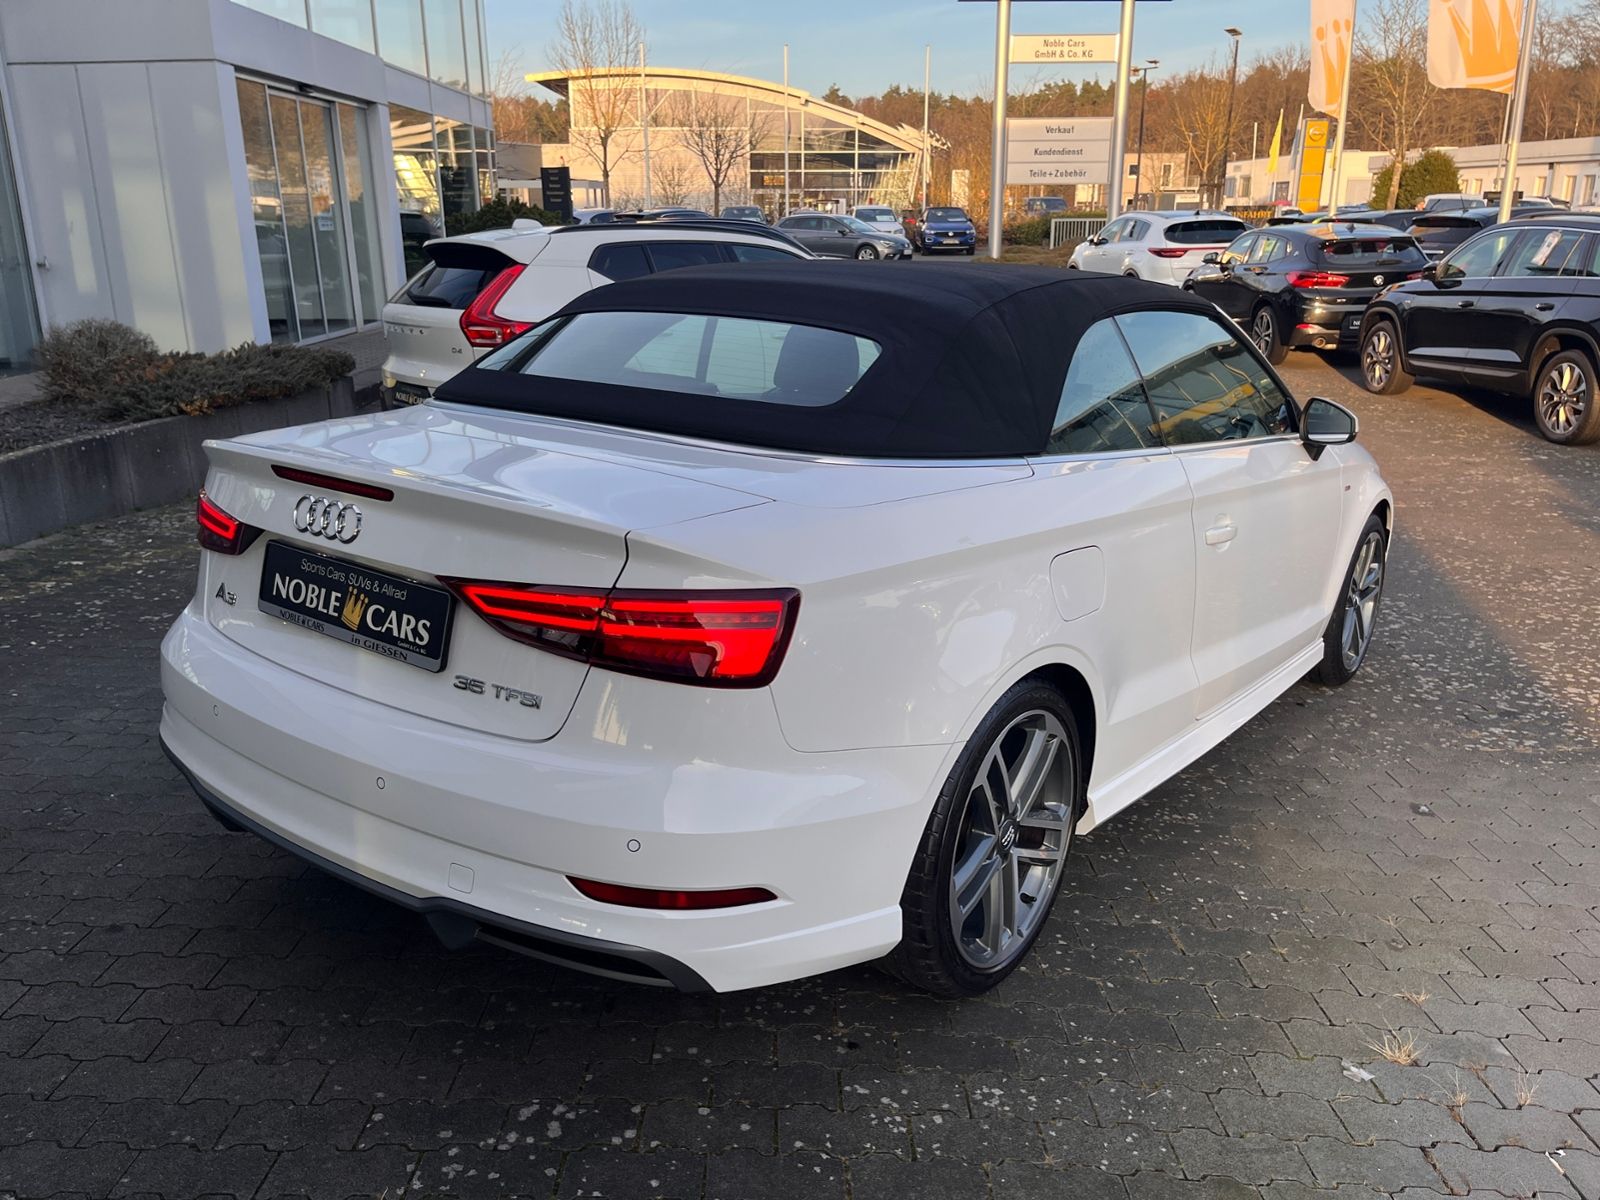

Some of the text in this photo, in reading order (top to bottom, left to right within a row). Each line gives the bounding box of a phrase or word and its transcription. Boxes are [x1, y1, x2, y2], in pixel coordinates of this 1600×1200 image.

[1034, 50, 1093, 58] GmbH & Co. KG
[1043, 39, 1085, 47] Noble Cars
[1045, 125, 1075, 134] Verkauf
[1034, 147, 1083, 156] Kundendienst
[1029, 169, 1087, 178] Teile+Zubehör
[301, 558, 408, 601] Sports Cars, SUVs & Allrad
[215, 582, 237, 606] A3
[272, 573, 431, 646] NOBLE CARS
[280, 609, 325, 632] NOBLE CARS
[351, 634, 408, 661] in GIESSEN
[453, 674, 543, 709] 35 TFSI
